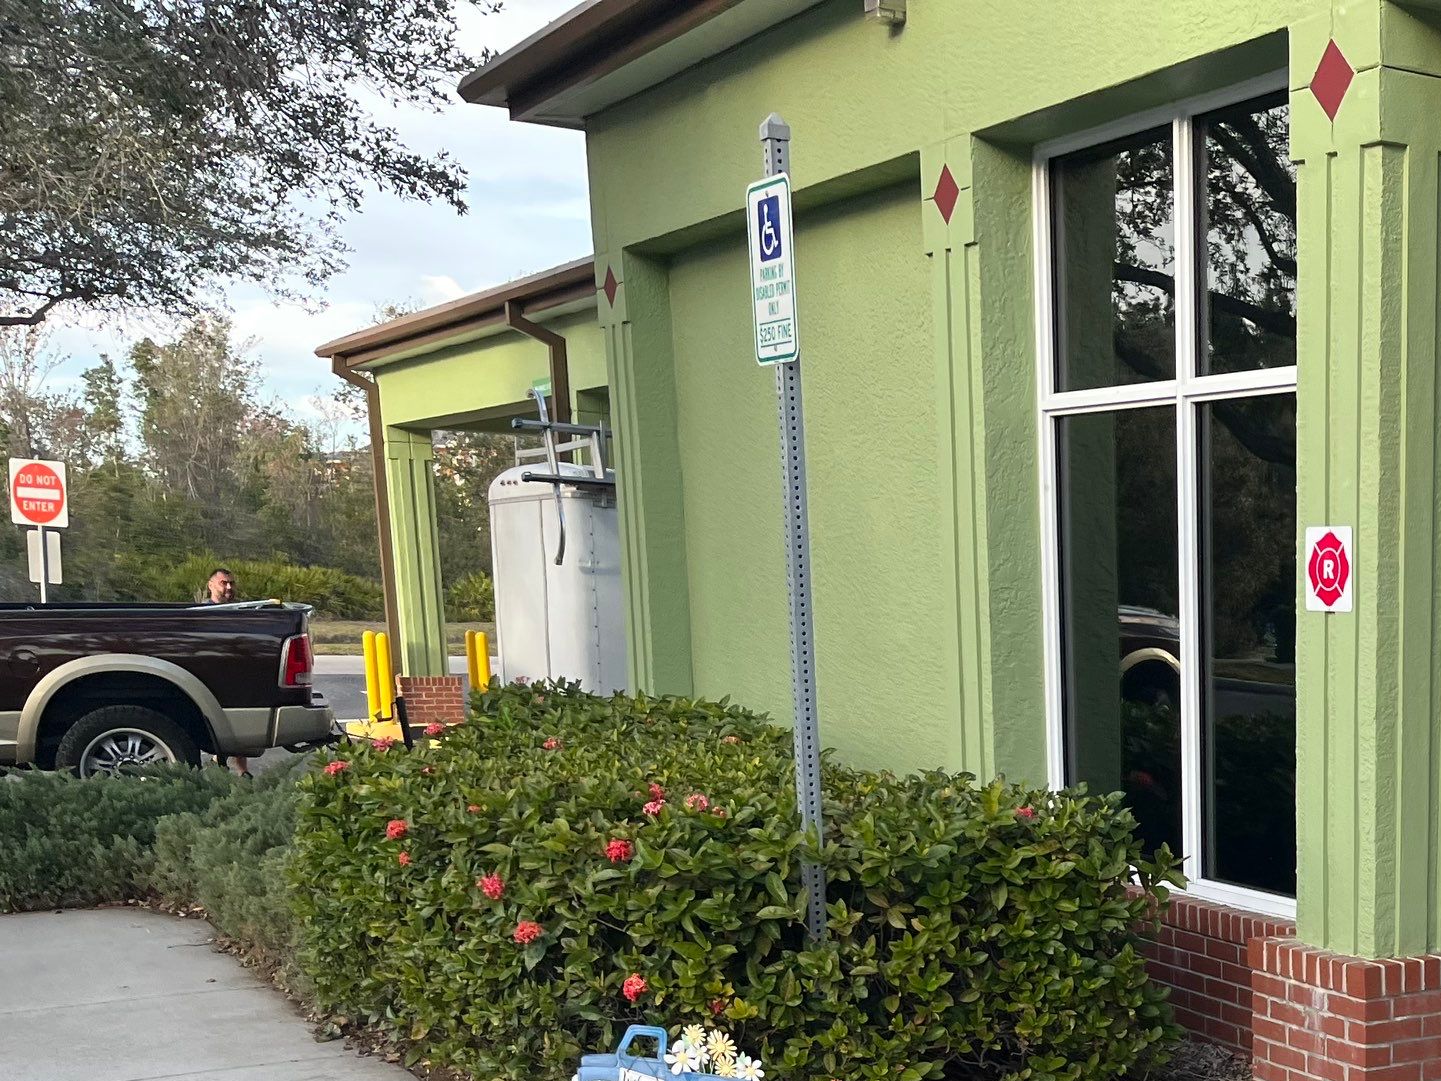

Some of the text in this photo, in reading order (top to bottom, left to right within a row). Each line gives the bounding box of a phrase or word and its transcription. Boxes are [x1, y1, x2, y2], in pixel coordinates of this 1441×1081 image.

[760, 322, 792, 344] $250 FINE
[19, 473, 56, 485] DO NOT
[23, 501, 54, 512] ENTER
[1323, 559, 1335, 580] R
